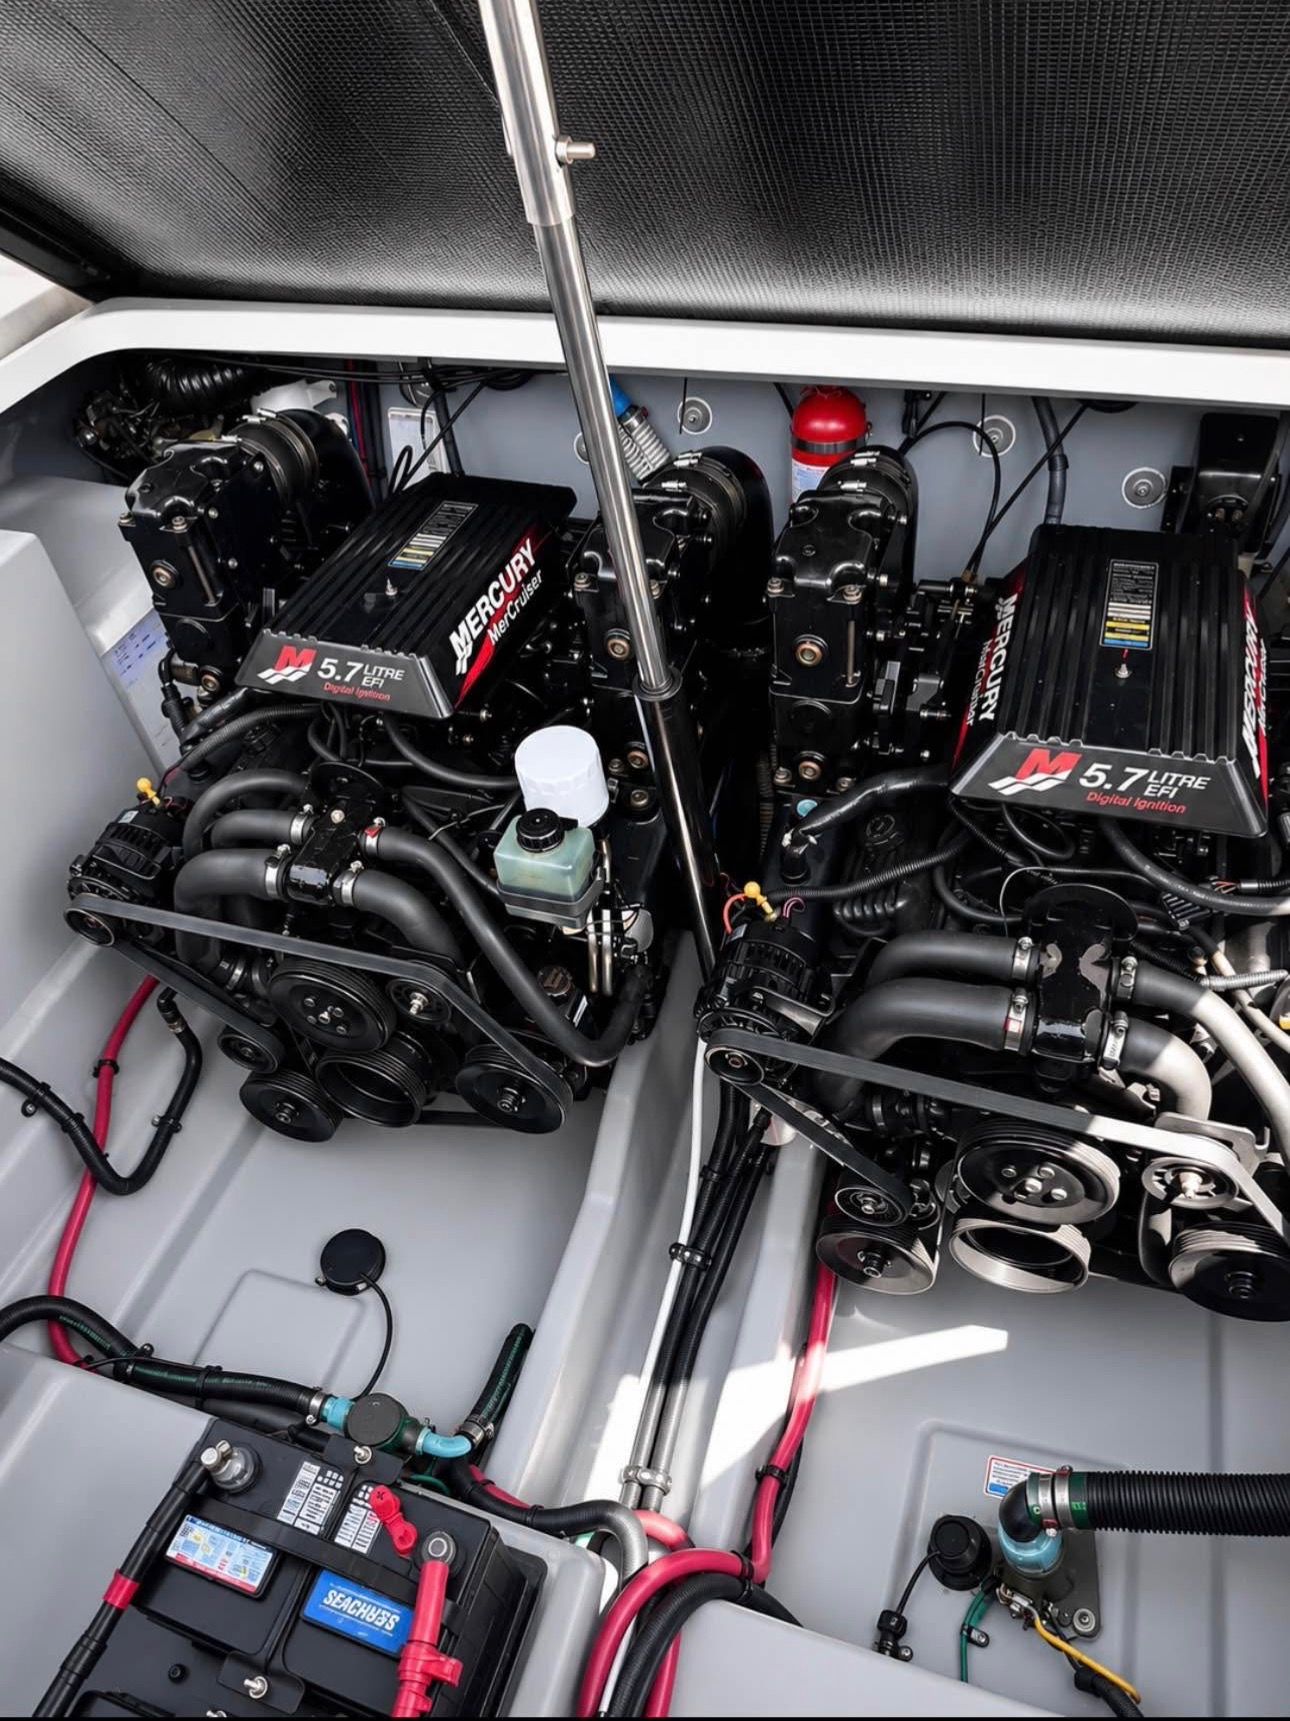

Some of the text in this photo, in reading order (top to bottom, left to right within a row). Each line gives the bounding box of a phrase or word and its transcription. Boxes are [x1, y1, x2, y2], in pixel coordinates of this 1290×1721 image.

[449, 538, 535, 657] MERCURY
[487, 569, 543, 646] MerCruiser
[979, 592, 1018, 721] MERCURY
[317, 657, 405, 682] 5.7 LITRE
[324, 682, 392, 702] Digital Ignition
[361, 676, 385, 689] EFI
[1078, 763, 1211, 792] 5.7 LITRE
[1086, 791, 1187, 813] Digital Ignition
[1144, 784, 1180, 799] EFI
